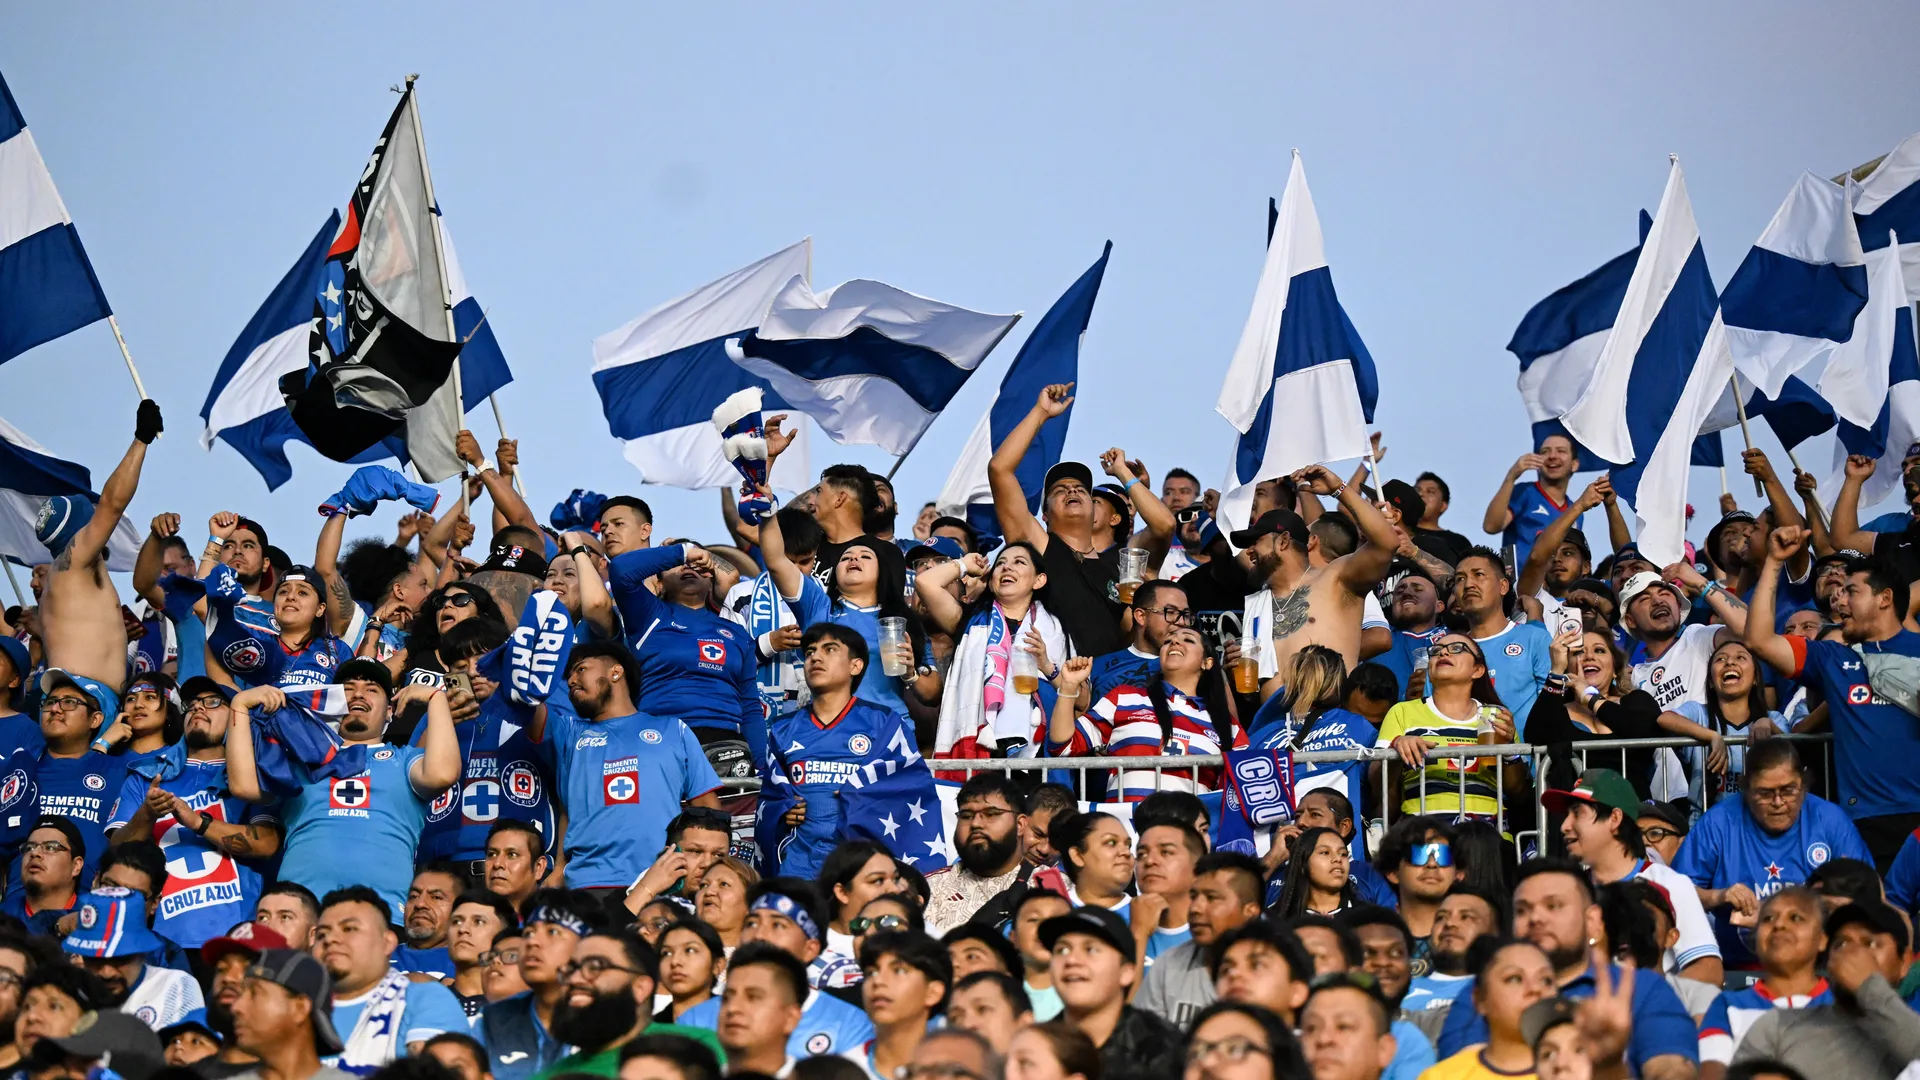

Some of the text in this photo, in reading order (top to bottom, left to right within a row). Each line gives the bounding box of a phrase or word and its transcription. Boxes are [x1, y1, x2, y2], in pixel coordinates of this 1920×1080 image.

[529, 611, 568, 694] CRUZ
[1666, 685, 1688, 705] AZUL
[604, 758, 639, 770] CEMENTO
[484, 768, 500, 778] AZ
[805, 773, 850, 785] CRUZ AZ
[40, 795, 100, 809] CEMENTO
[70, 809, 100, 824] AZUL
[328, 808, 370, 820] CRUZ AZUL
[164, 882, 241, 915] CRUZ AZUL
